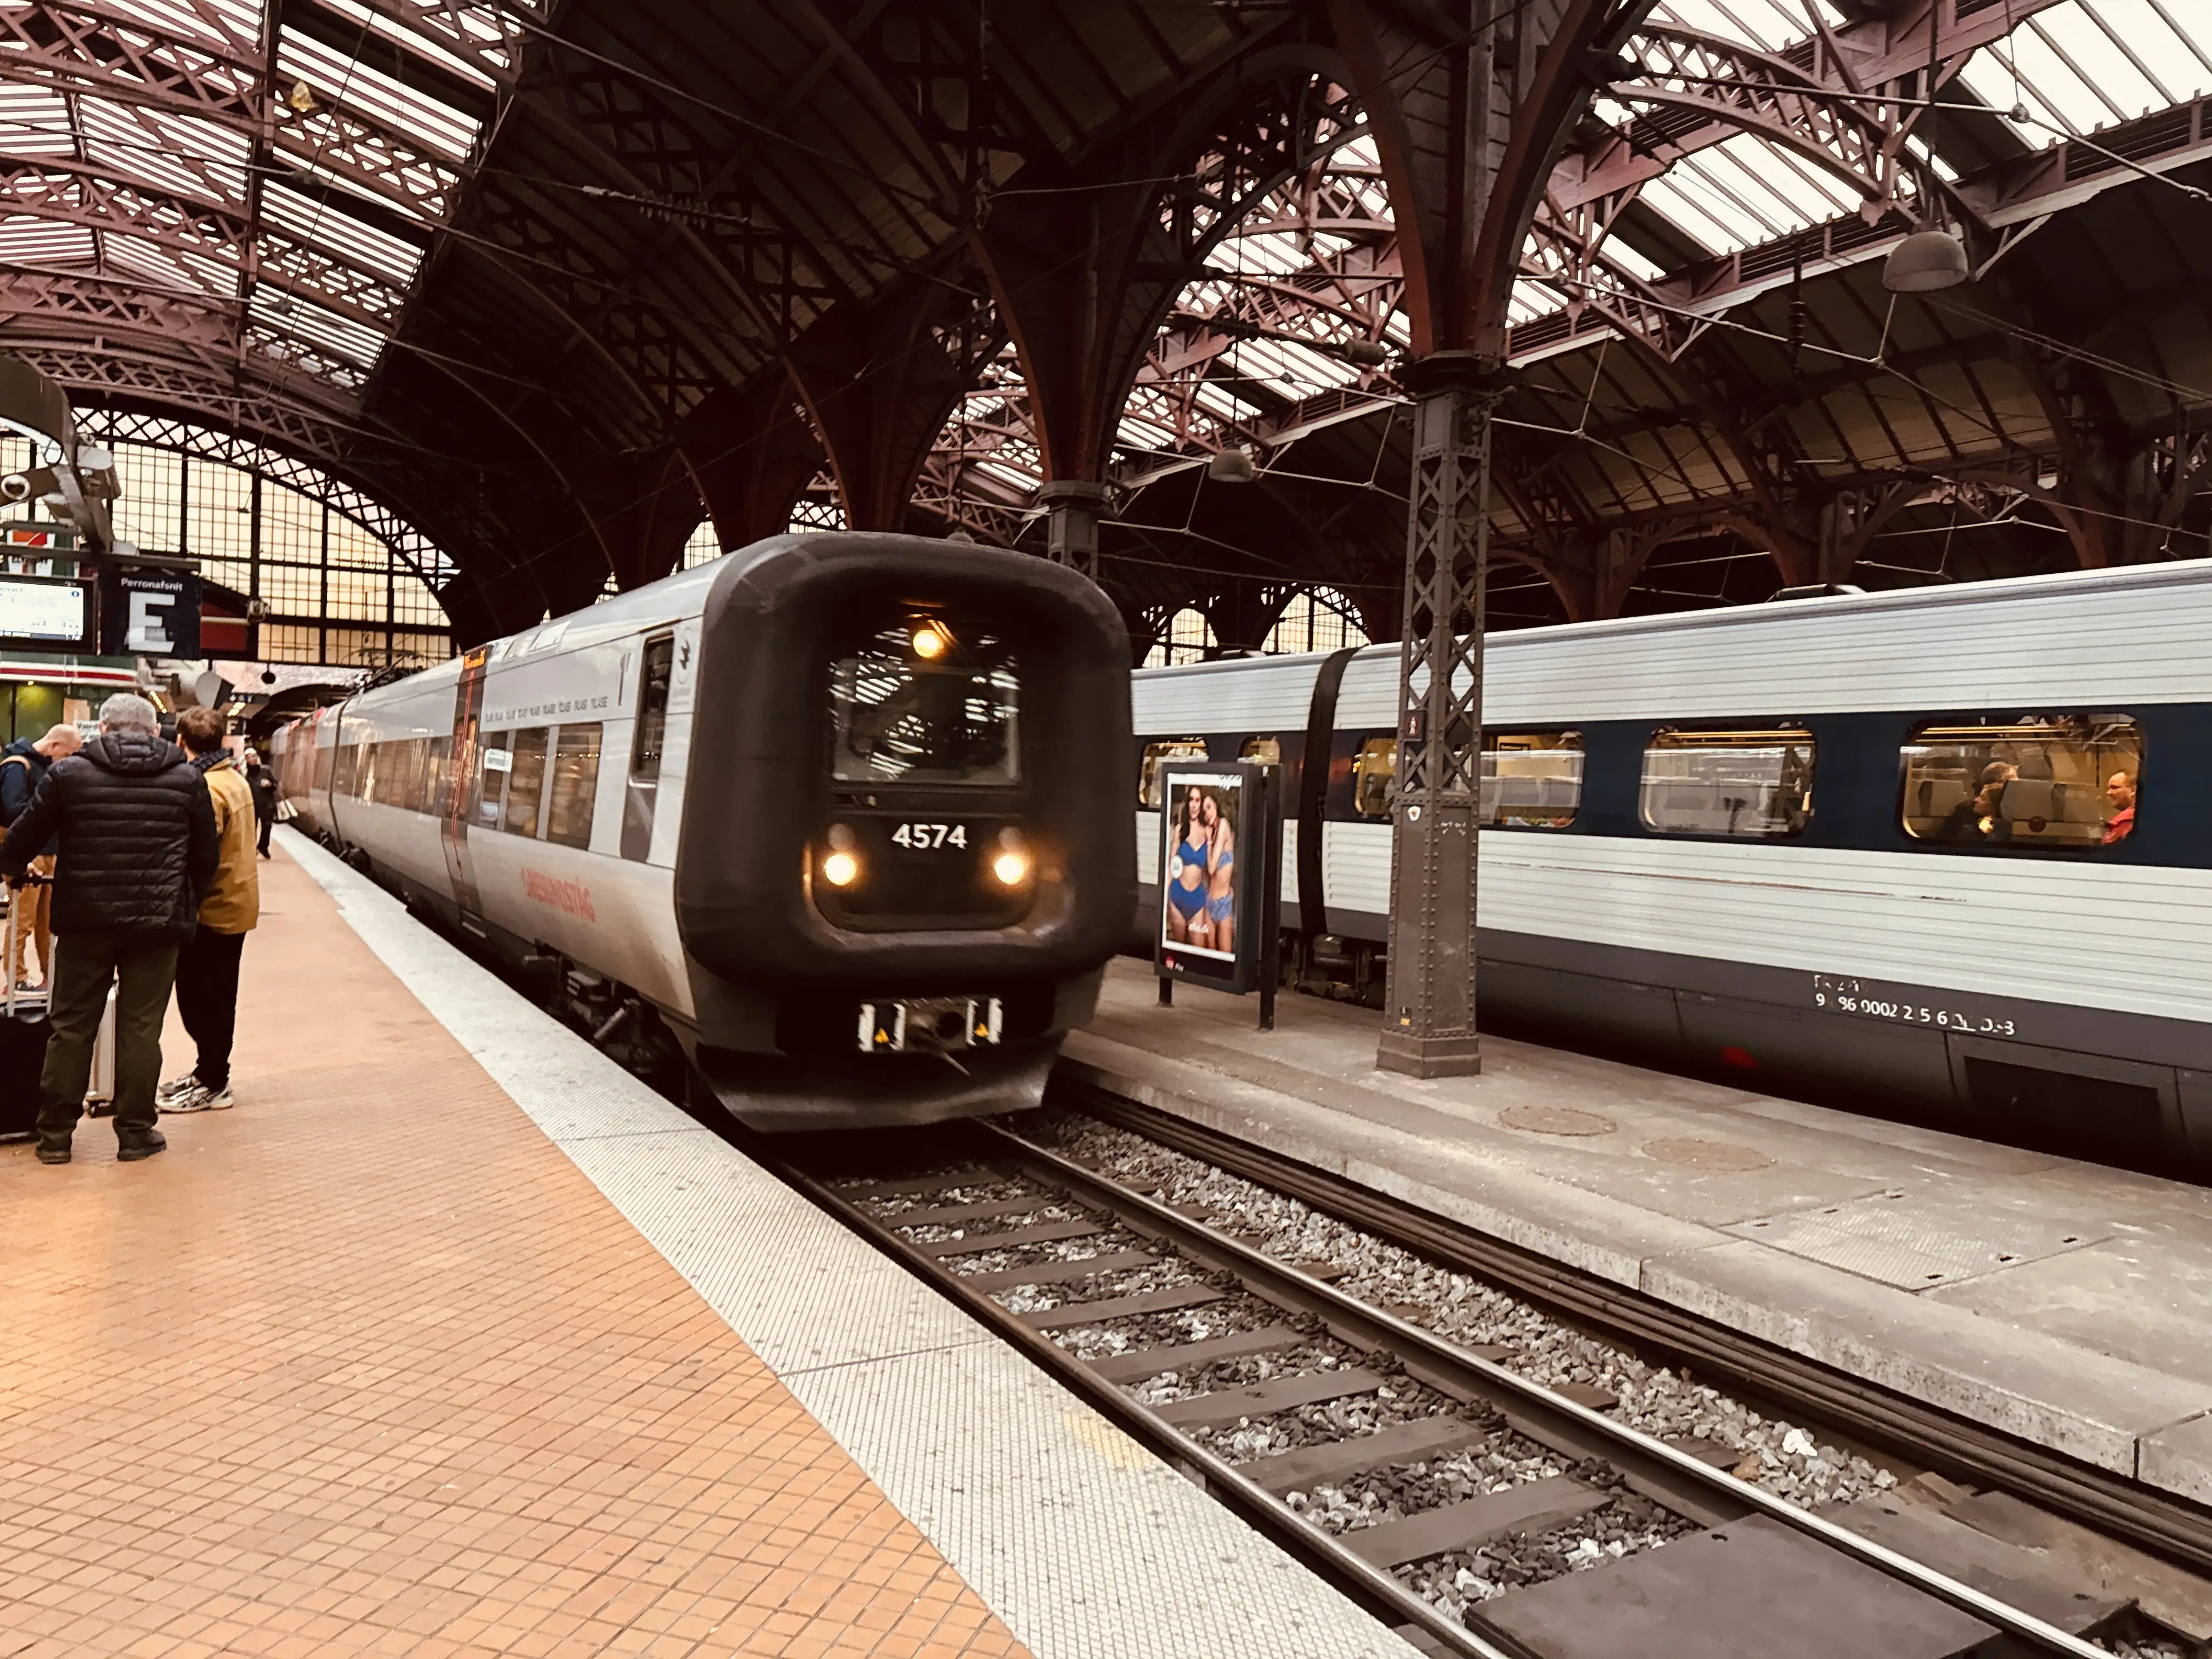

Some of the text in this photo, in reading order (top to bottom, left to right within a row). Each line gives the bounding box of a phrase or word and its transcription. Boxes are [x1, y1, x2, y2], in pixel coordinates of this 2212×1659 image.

[121, 577, 183, 592] Perronafsnit
[128, 591, 175, 653] E
[226, 719, 238, 735] F
[891, 823, 968, 849] 4574
